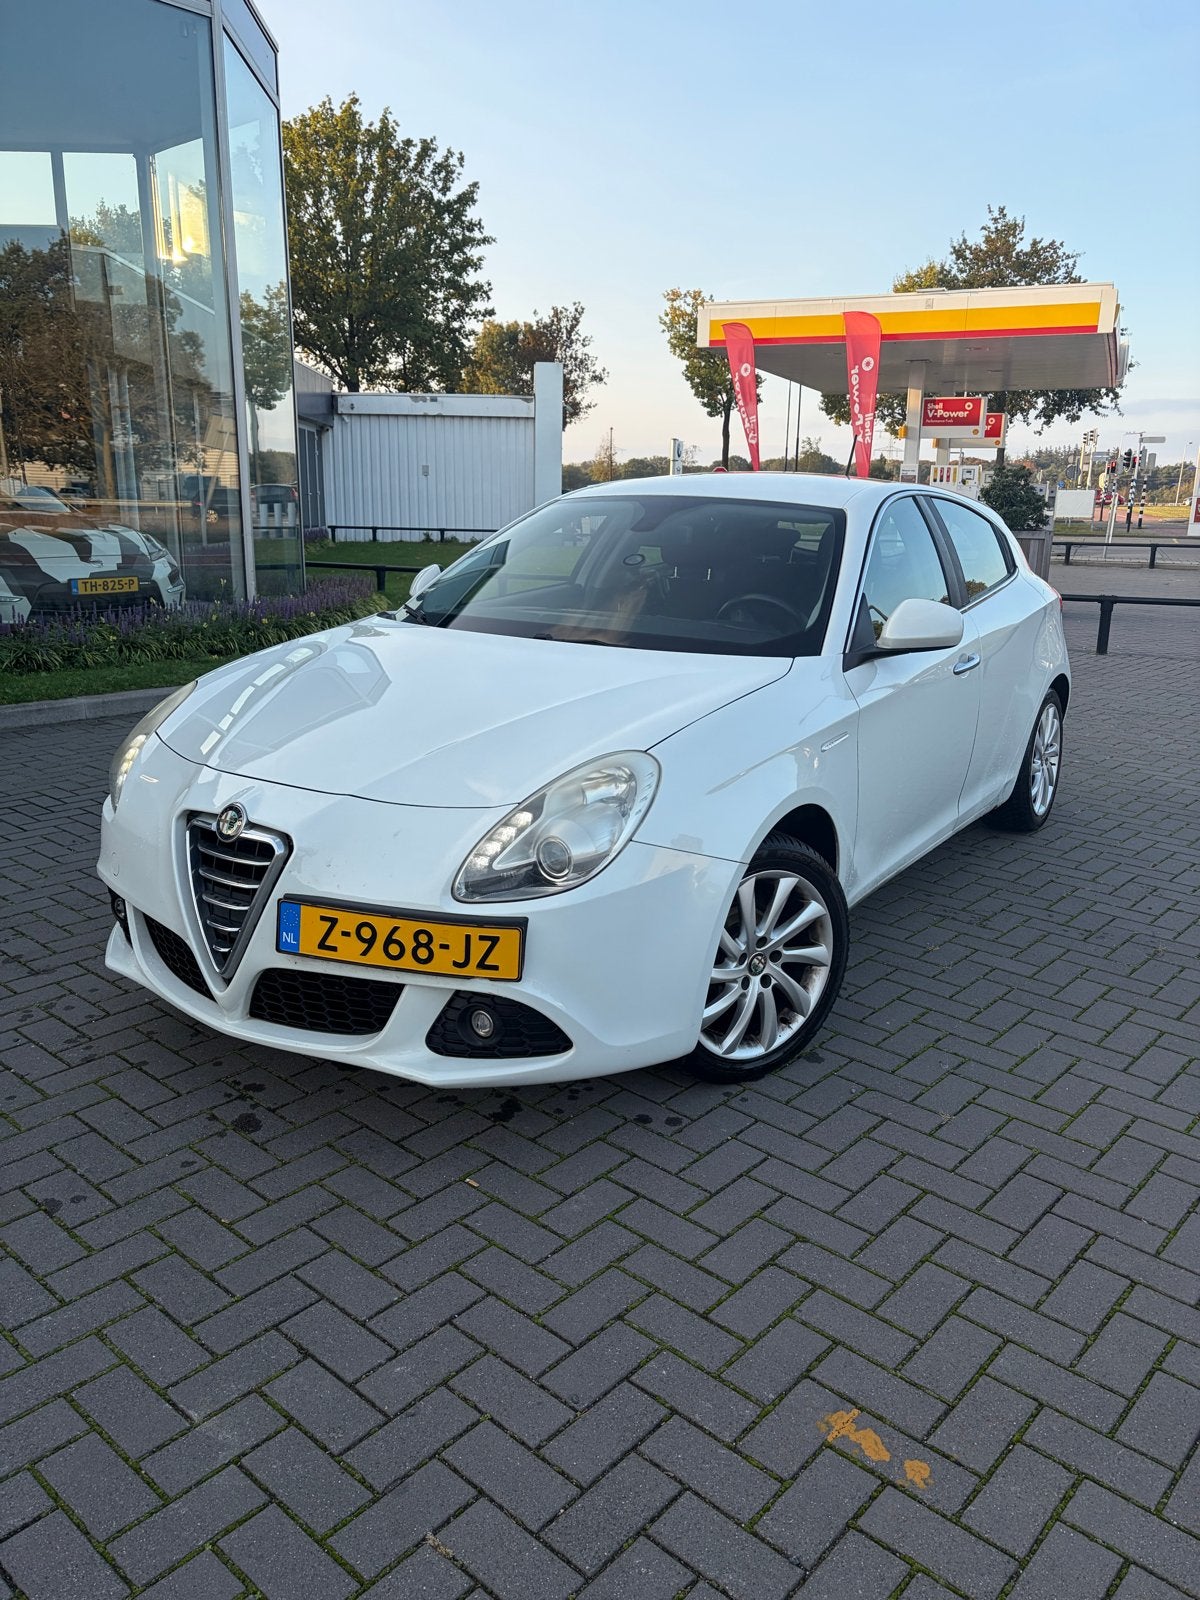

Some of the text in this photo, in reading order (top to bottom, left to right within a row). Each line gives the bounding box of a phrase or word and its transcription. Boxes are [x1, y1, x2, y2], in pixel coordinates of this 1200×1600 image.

[927, 402, 944, 410] Shell
[927, 409, 970, 418] V-Power
[82, 579, 135, 592] TH-825-P
[282, 931, 297, 945] NL
[317, 914, 501, 971] Z-968-JZ
